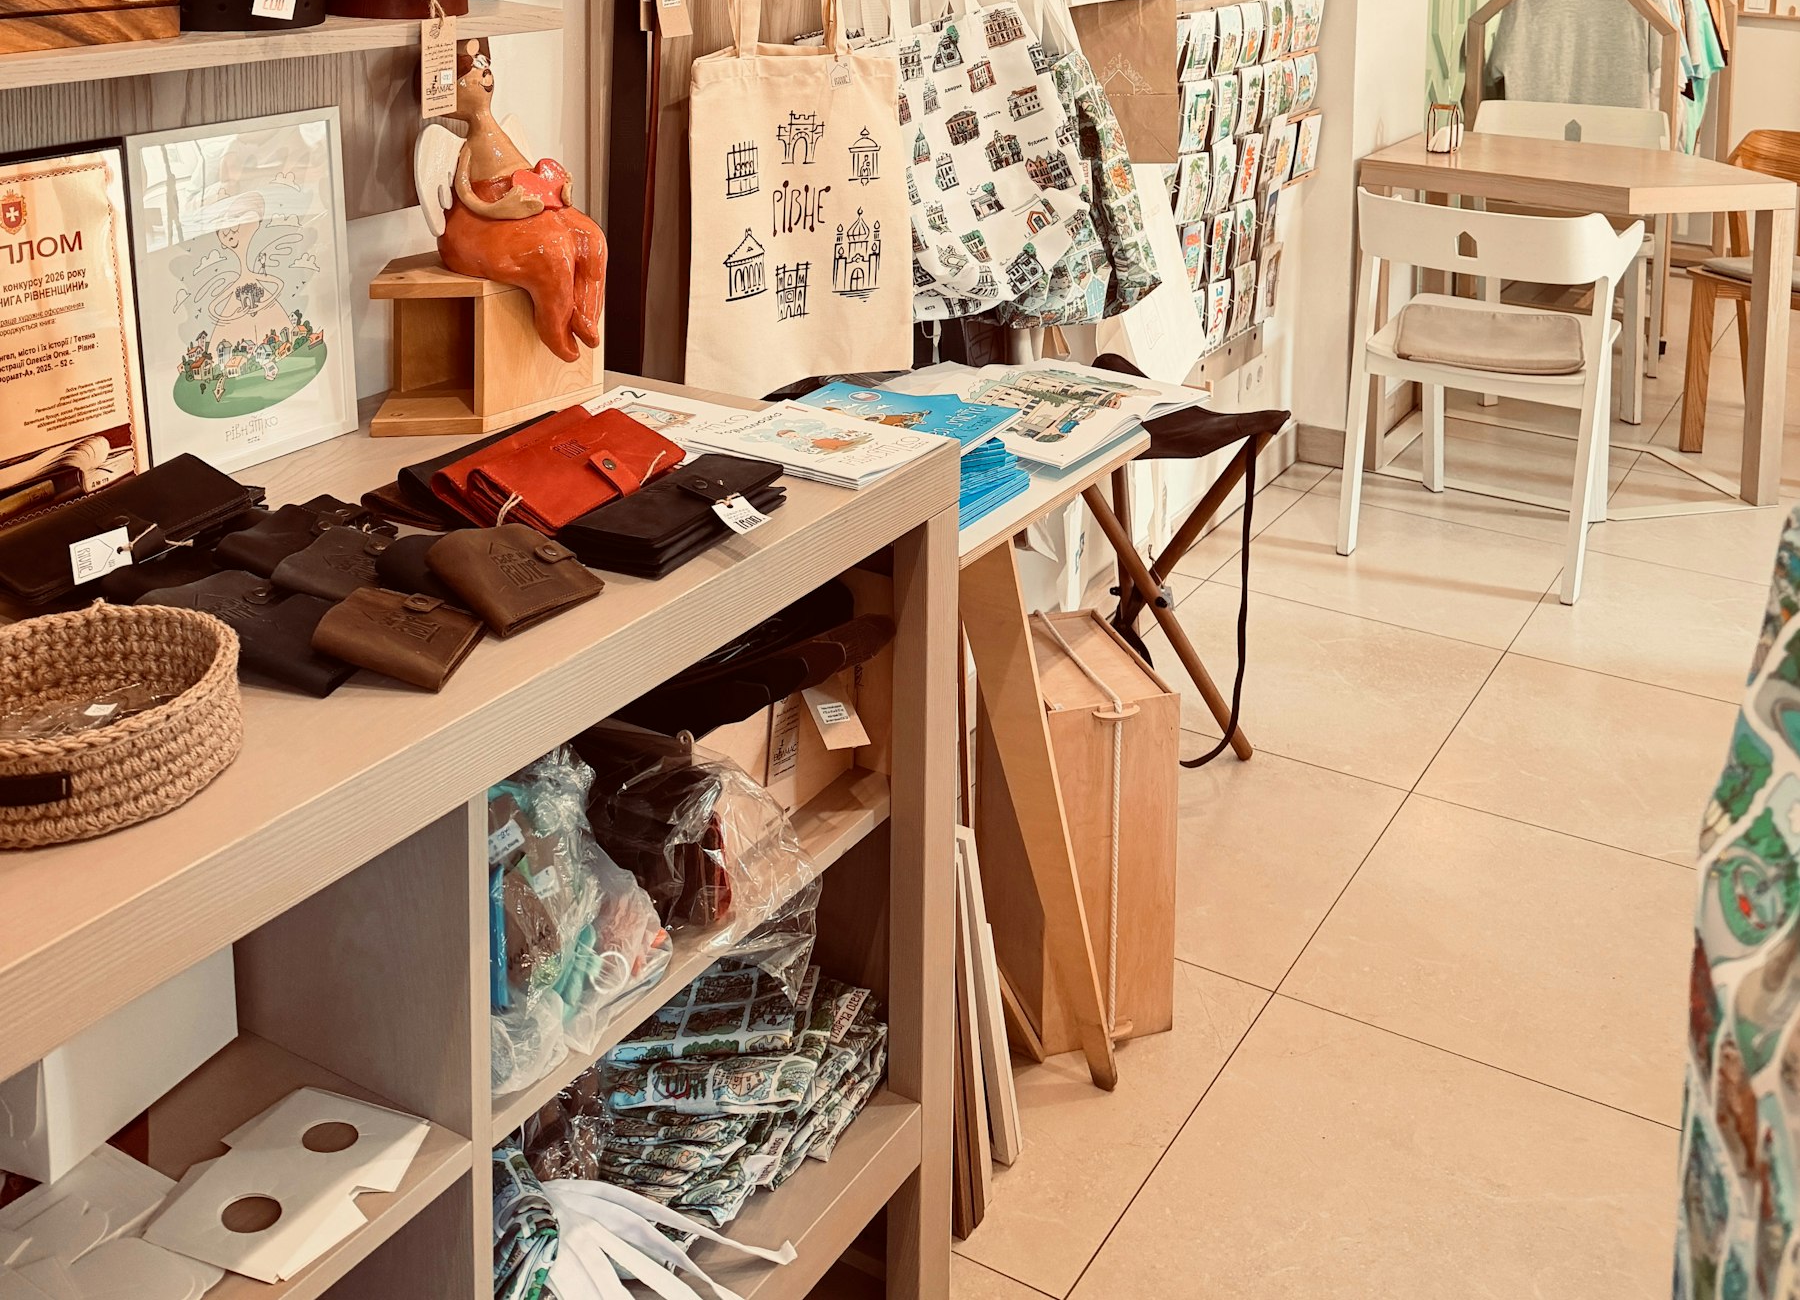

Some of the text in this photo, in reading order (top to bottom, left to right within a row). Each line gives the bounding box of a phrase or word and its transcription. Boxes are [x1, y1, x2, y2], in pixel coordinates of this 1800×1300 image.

[3, 268, 87, 293] конкурсу 2026 року
